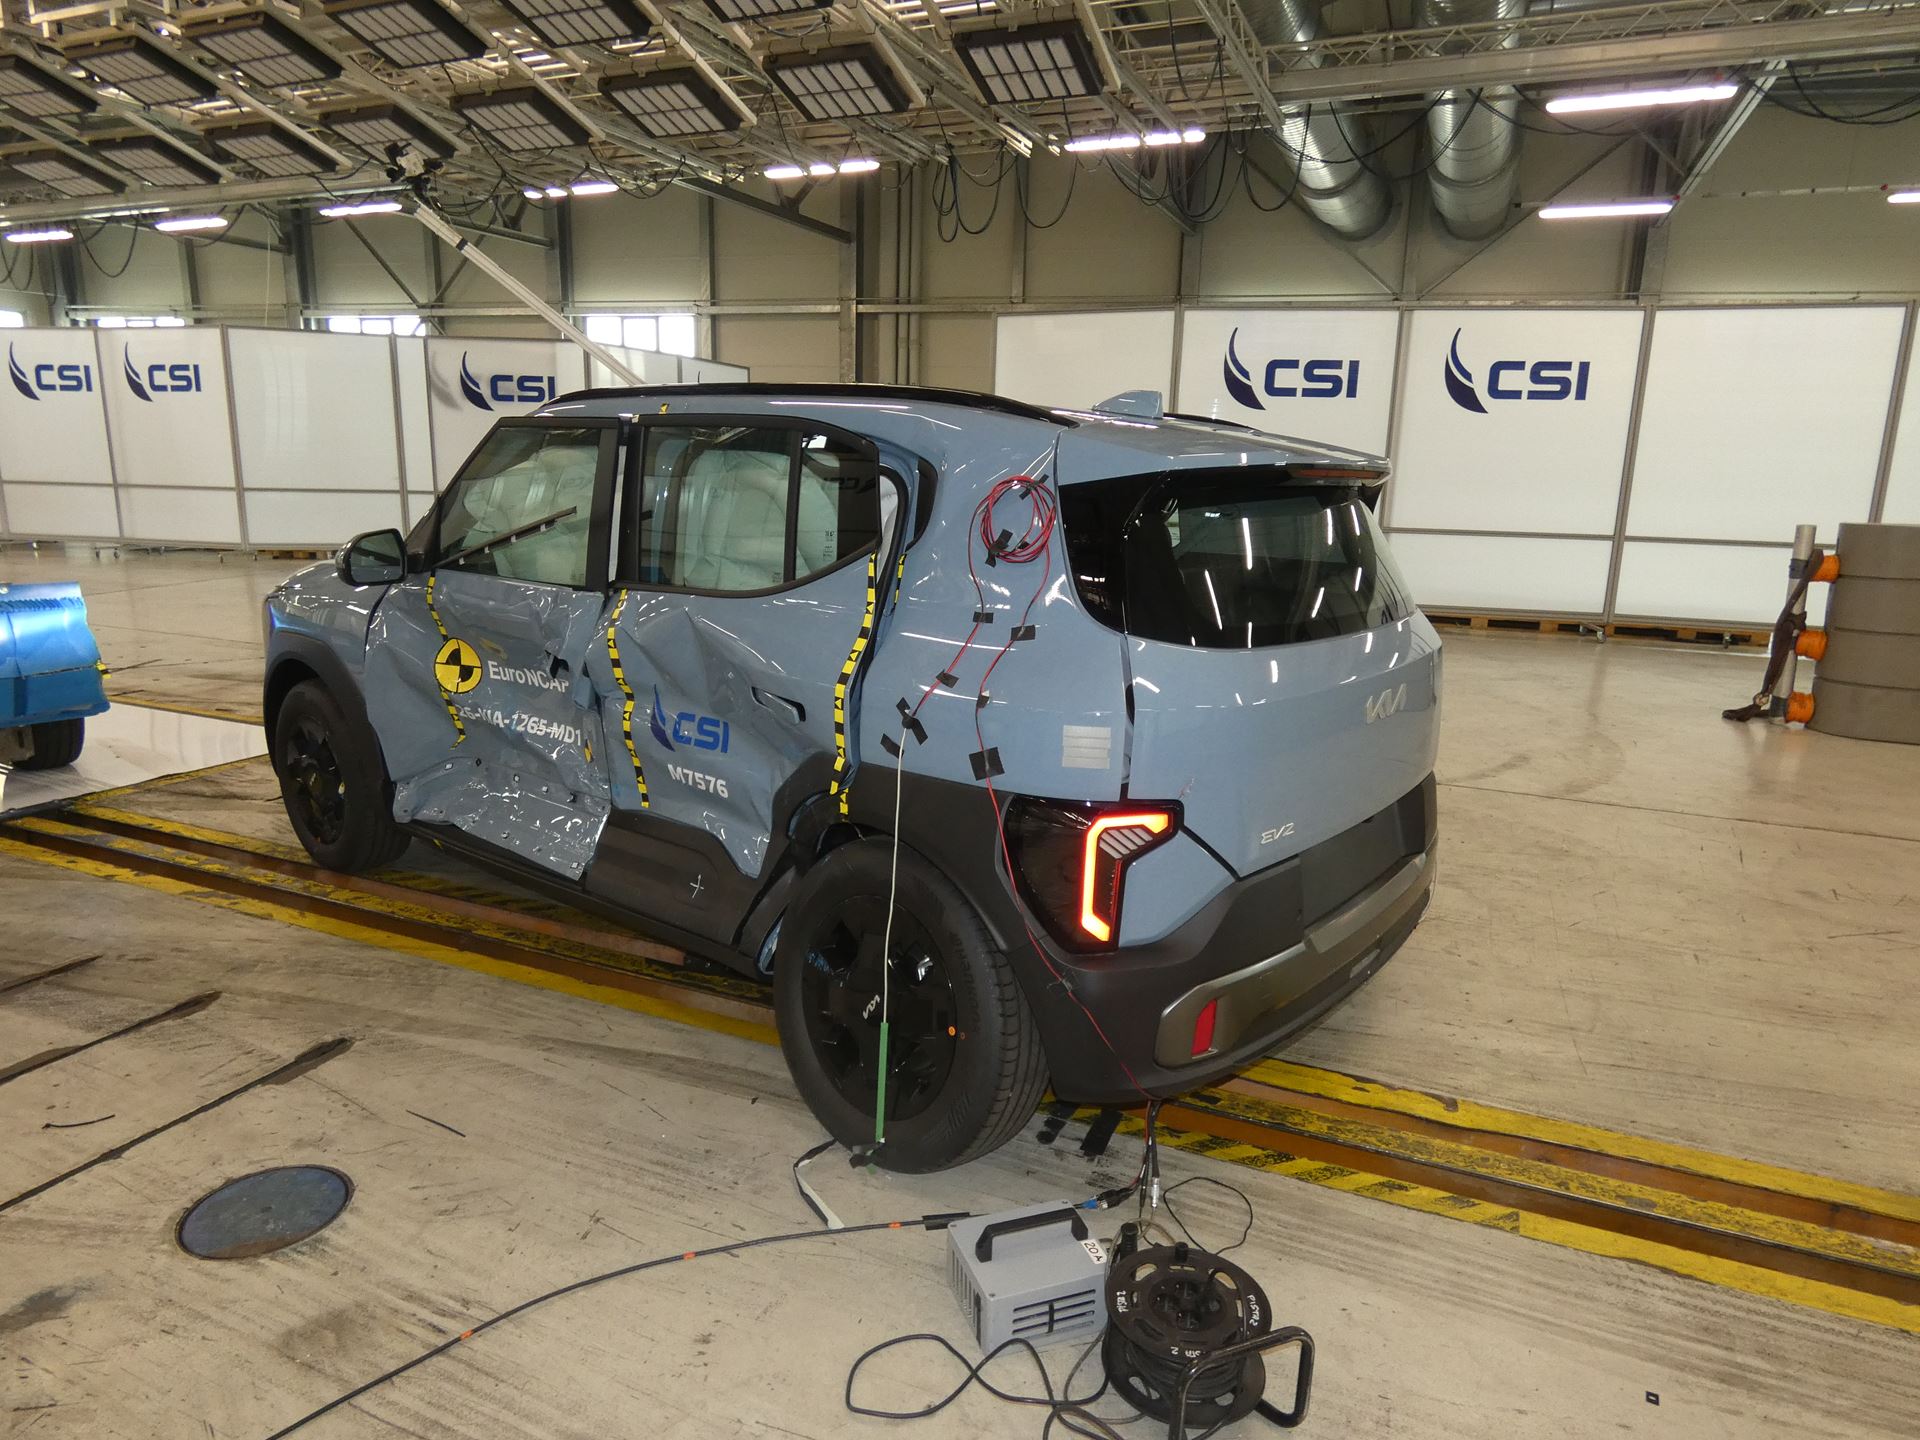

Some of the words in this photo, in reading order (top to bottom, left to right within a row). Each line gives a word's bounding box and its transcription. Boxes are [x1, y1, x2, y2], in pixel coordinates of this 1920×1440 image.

[34, 364, 93, 392] CSI
[147, 364, 202, 392] CSI
[490, 374, 556, 403] CSI
[1264, 359, 1360, 398] CSI
[1487, 360, 1591, 400] CSI
[1366, 682, 1407, 724] KIA
[672, 711, 730, 754] CSI
[667, 763, 729, 799] M7576
[1261, 822, 1296, 844] EV2
